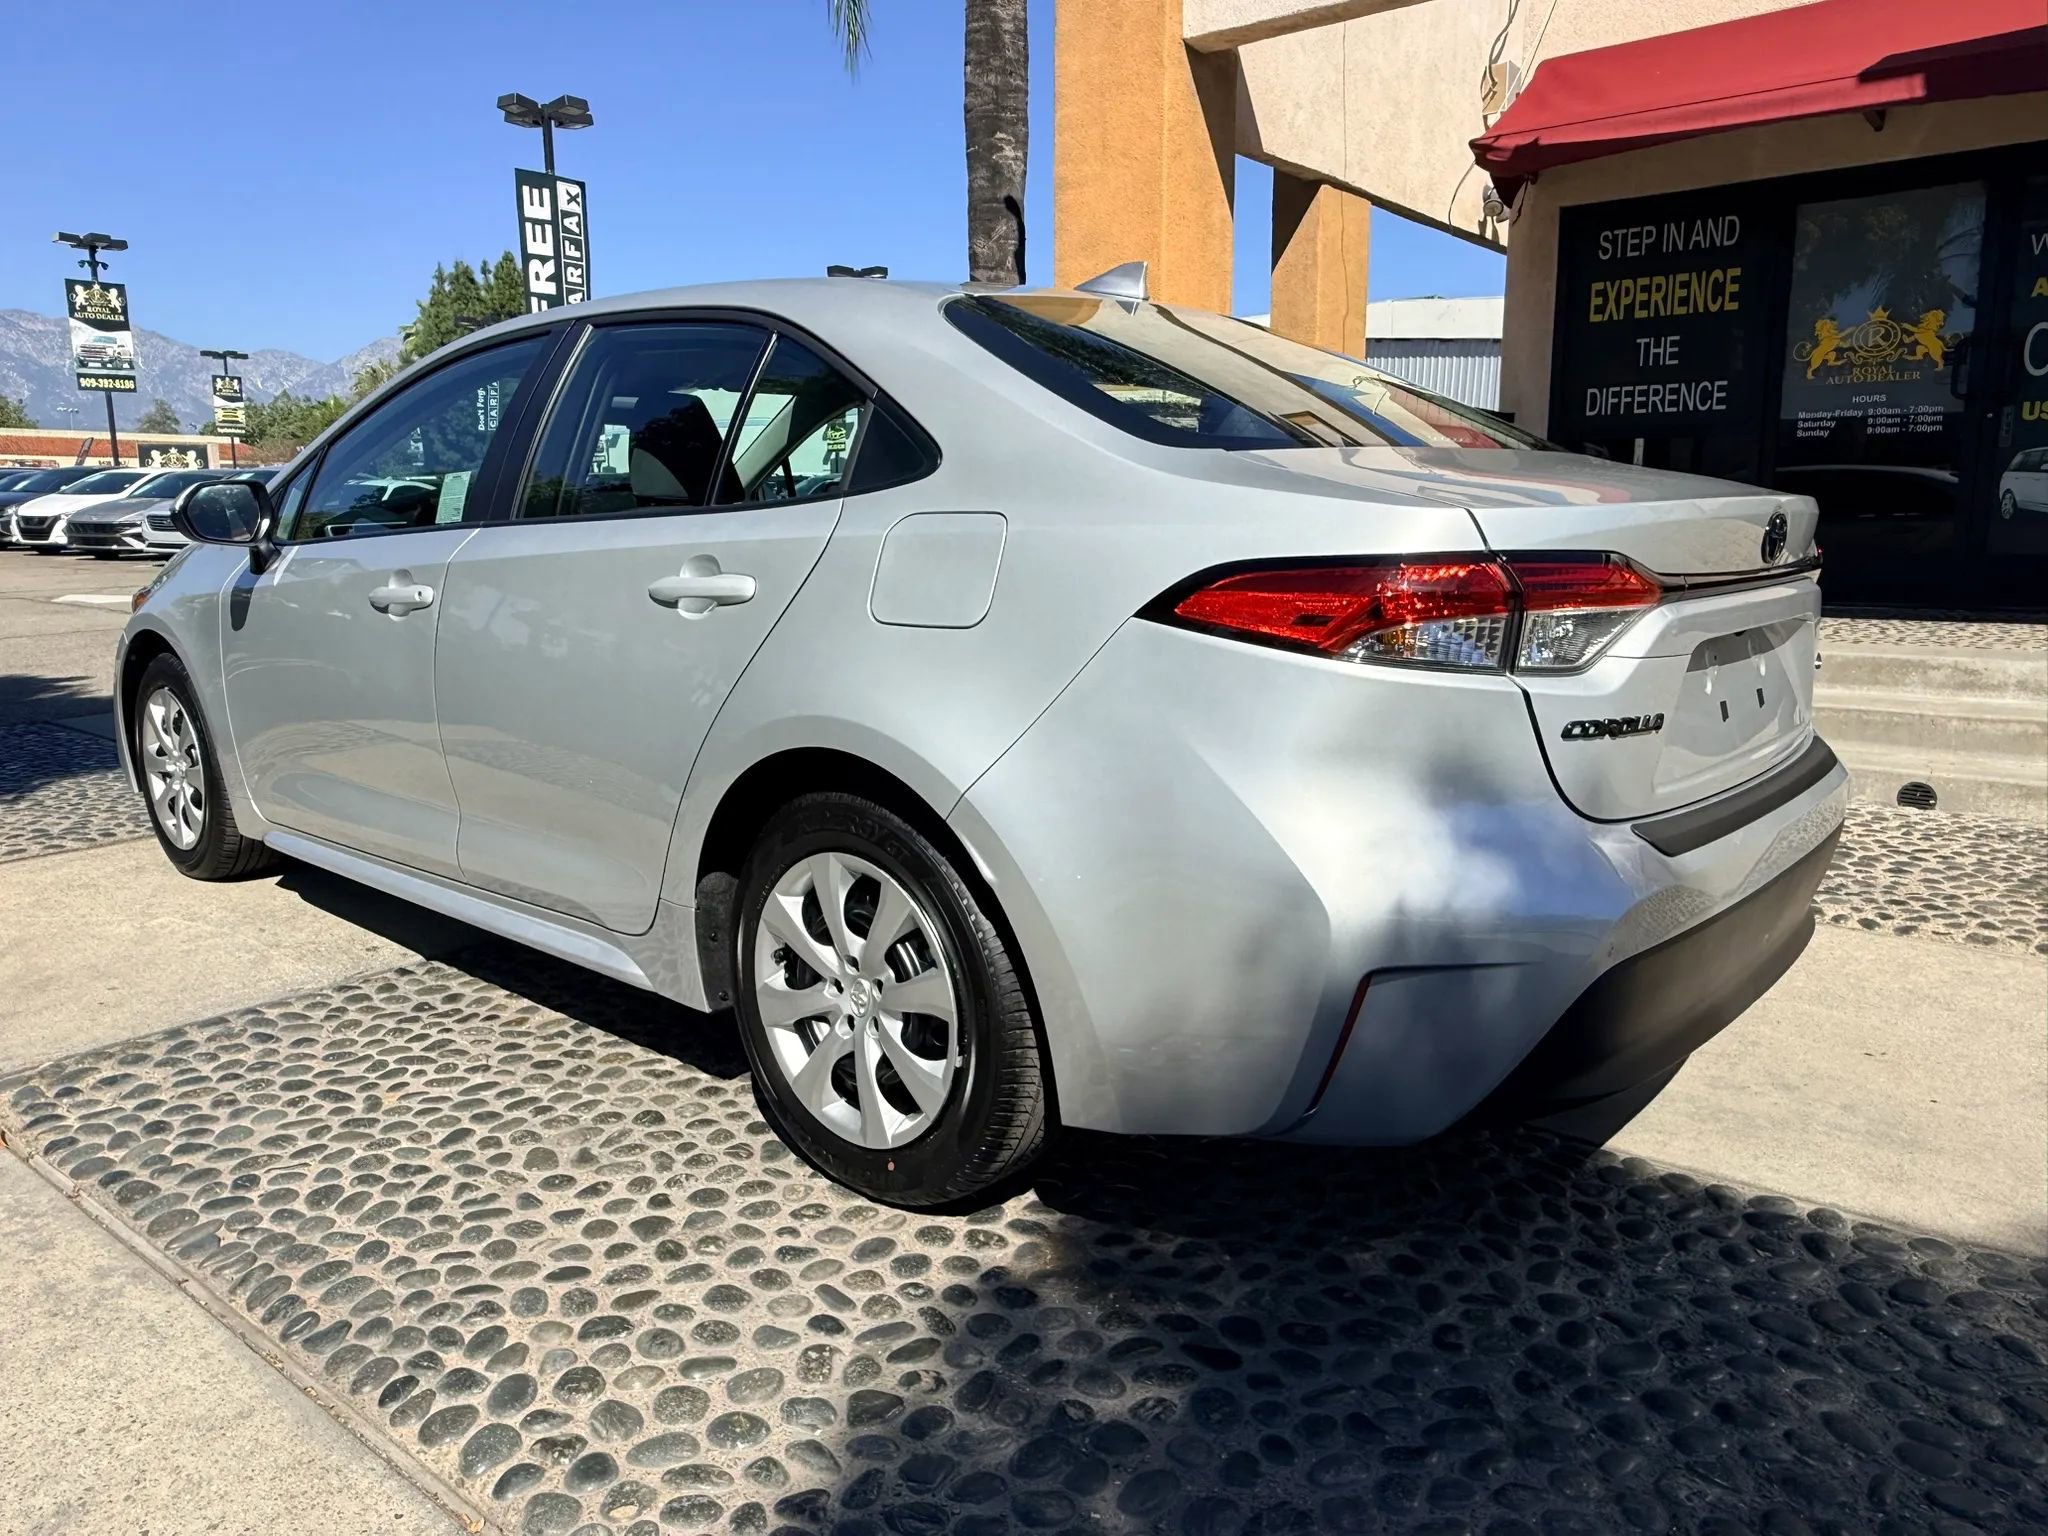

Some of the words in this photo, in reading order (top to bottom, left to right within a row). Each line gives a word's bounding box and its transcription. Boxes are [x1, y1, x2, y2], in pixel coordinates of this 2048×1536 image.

[1598, 225, 1657, 260] STEP
[1662, 221, 1685, 253] IN
[1689, 215, 1741, 250] AND
[1589, 267, 1742, 322] EXPERIENCE
[86, 305, 112, 314] ROYAL
[73, 312, 96, 320] AUTO
[96, 313, 126, 322] DEALER
[1636, 336, 1681, 367] THE
[1852, 365, 1897, 377] ROYAL
[1825, 373, 1864, 385] AUTO
[1866, 371, 1920, 383] DEALER
[1585, 380, 1729, 416] DIFFERENCE
[1852, 394, 1887, 404] HOURS
[1798, 409, 1863, 420] Monday-Friday
[1797, 420, 1837, 430] Saturday
[1796, 429, 1830, 439] Sunday
